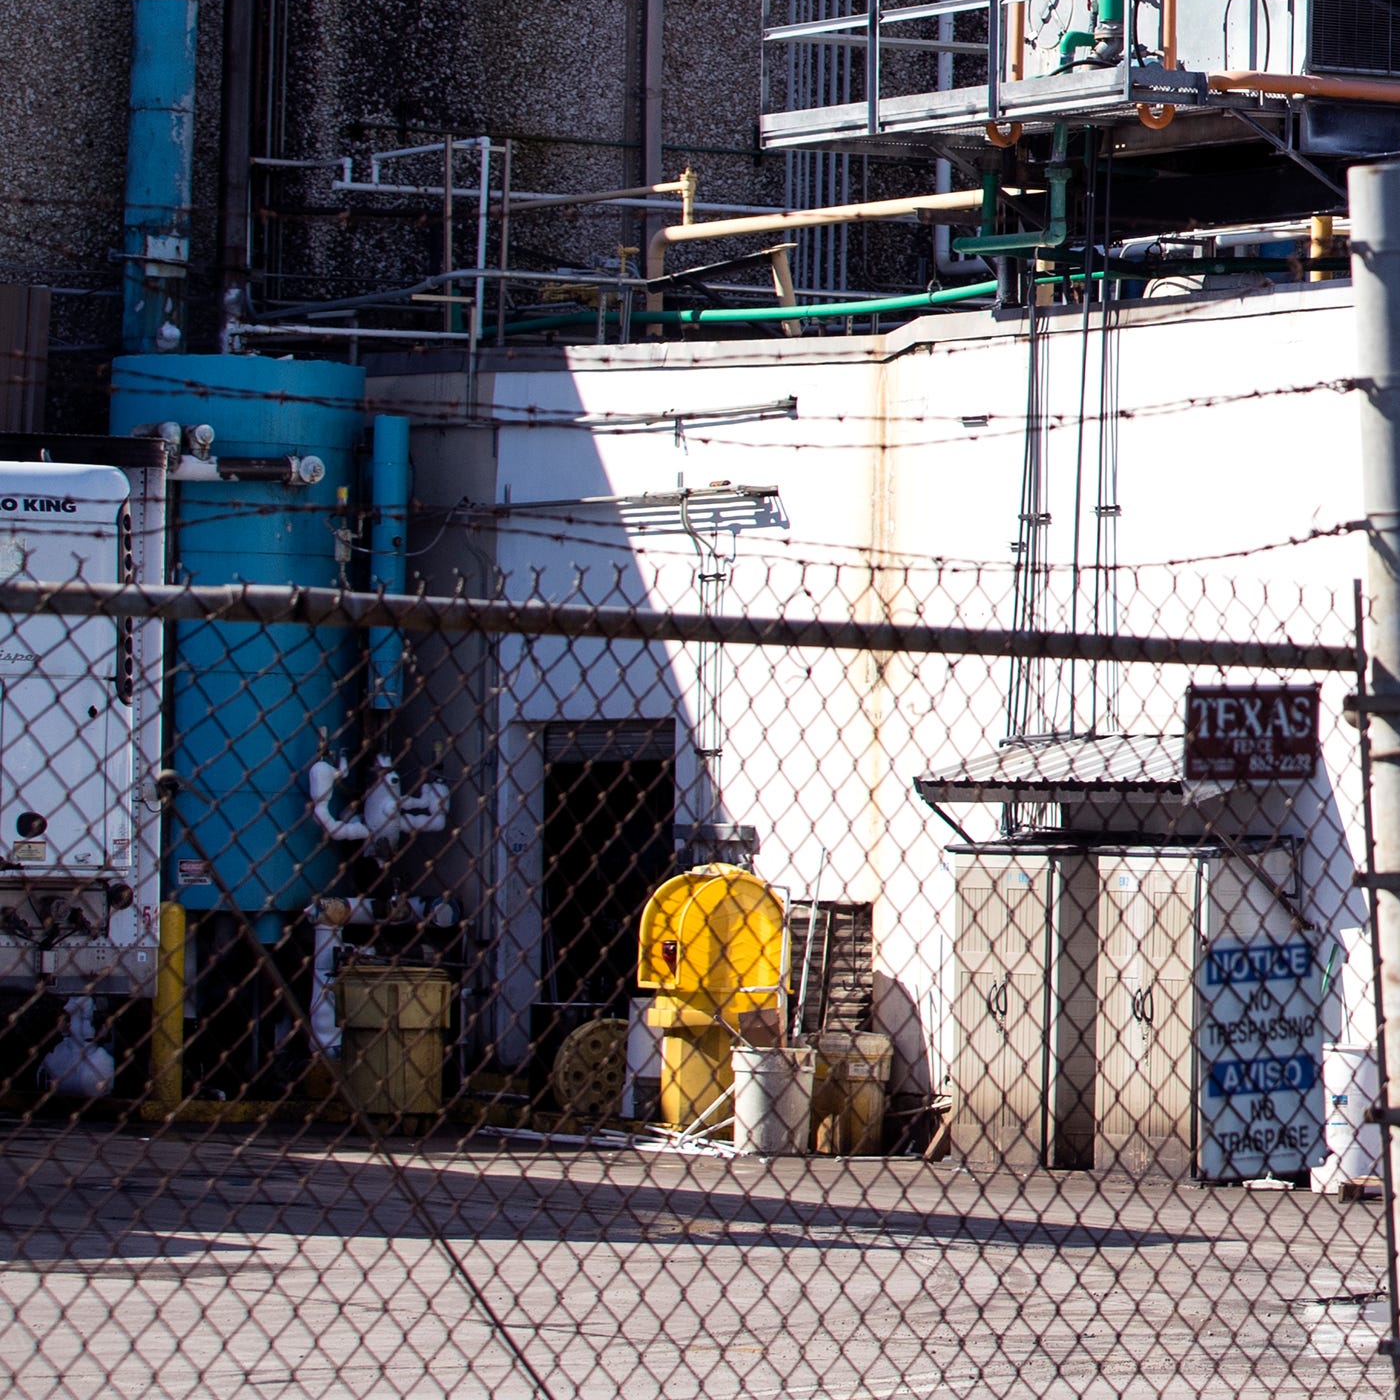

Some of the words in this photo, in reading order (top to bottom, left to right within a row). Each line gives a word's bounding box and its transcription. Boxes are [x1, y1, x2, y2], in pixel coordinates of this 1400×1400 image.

[23, 498, 77, 513] KING
[1191, 696, 1312, 739] TEXAS
[1211, 948, 1307, 980] NOTICE
[1250, 988, 1271, 1012] NO
[1207, 1015, 1315, 1046] TRESPASSING
[1223, 1064, 1302, 1092] AVISO
[1251, 1098, 1275, 1122] NO
[1218, 1125, 1310, 1154] TRASPASE
